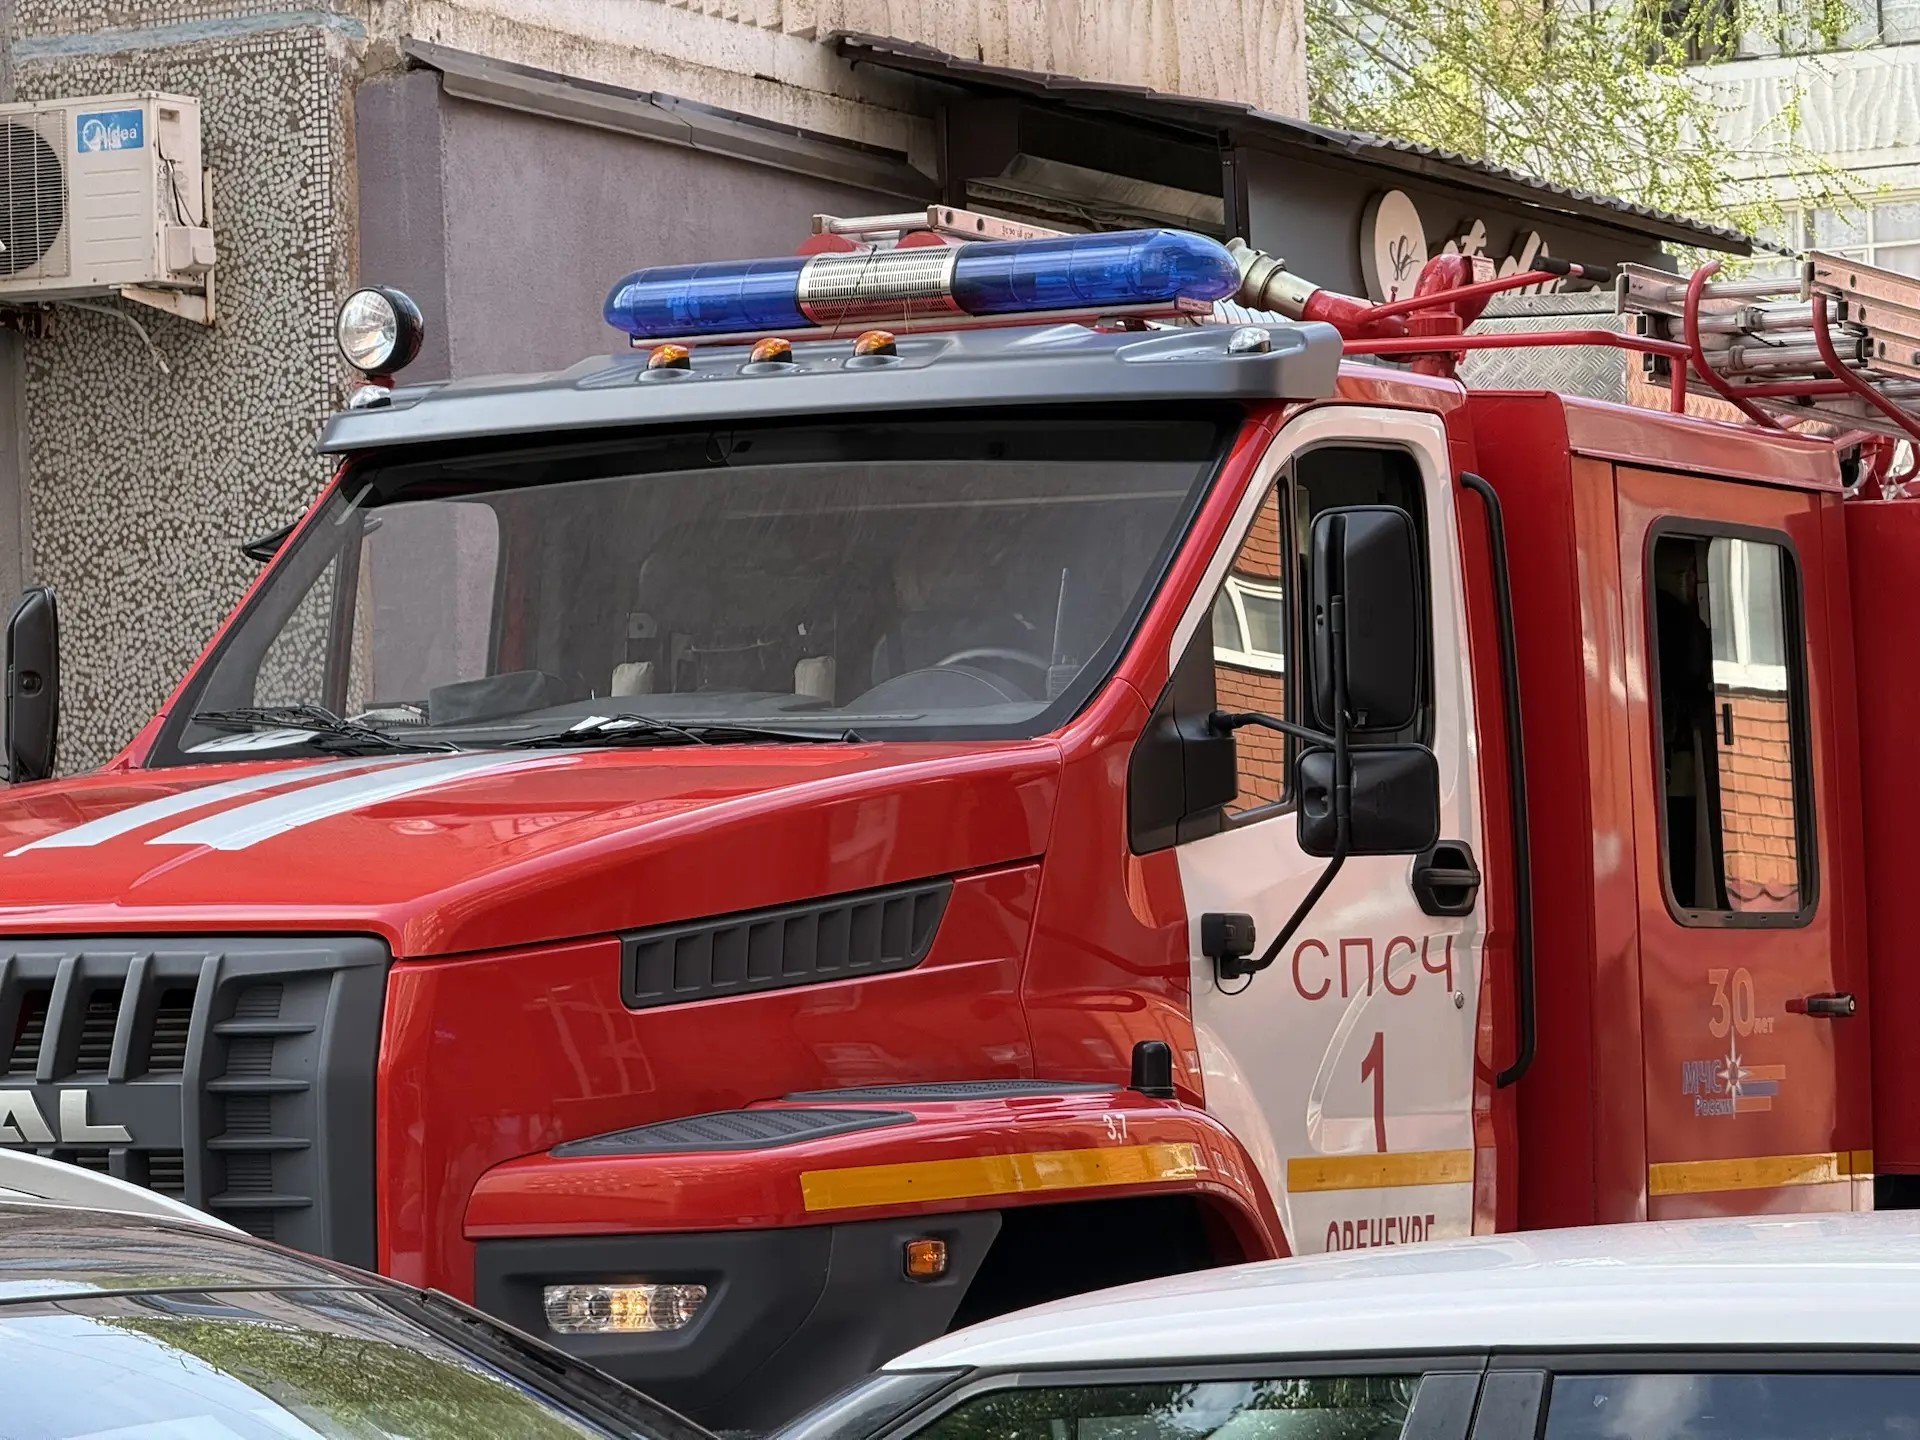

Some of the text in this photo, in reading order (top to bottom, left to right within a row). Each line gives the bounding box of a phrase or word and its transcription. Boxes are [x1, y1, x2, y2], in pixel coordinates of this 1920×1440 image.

[1292, 935, 1453, 1000] СПСЧ
[1708, 967, 1755, 1038] 30
[1361, 1031, 1387, 1153] 1
[1682, 1059, 1722, 1095] МЧС
